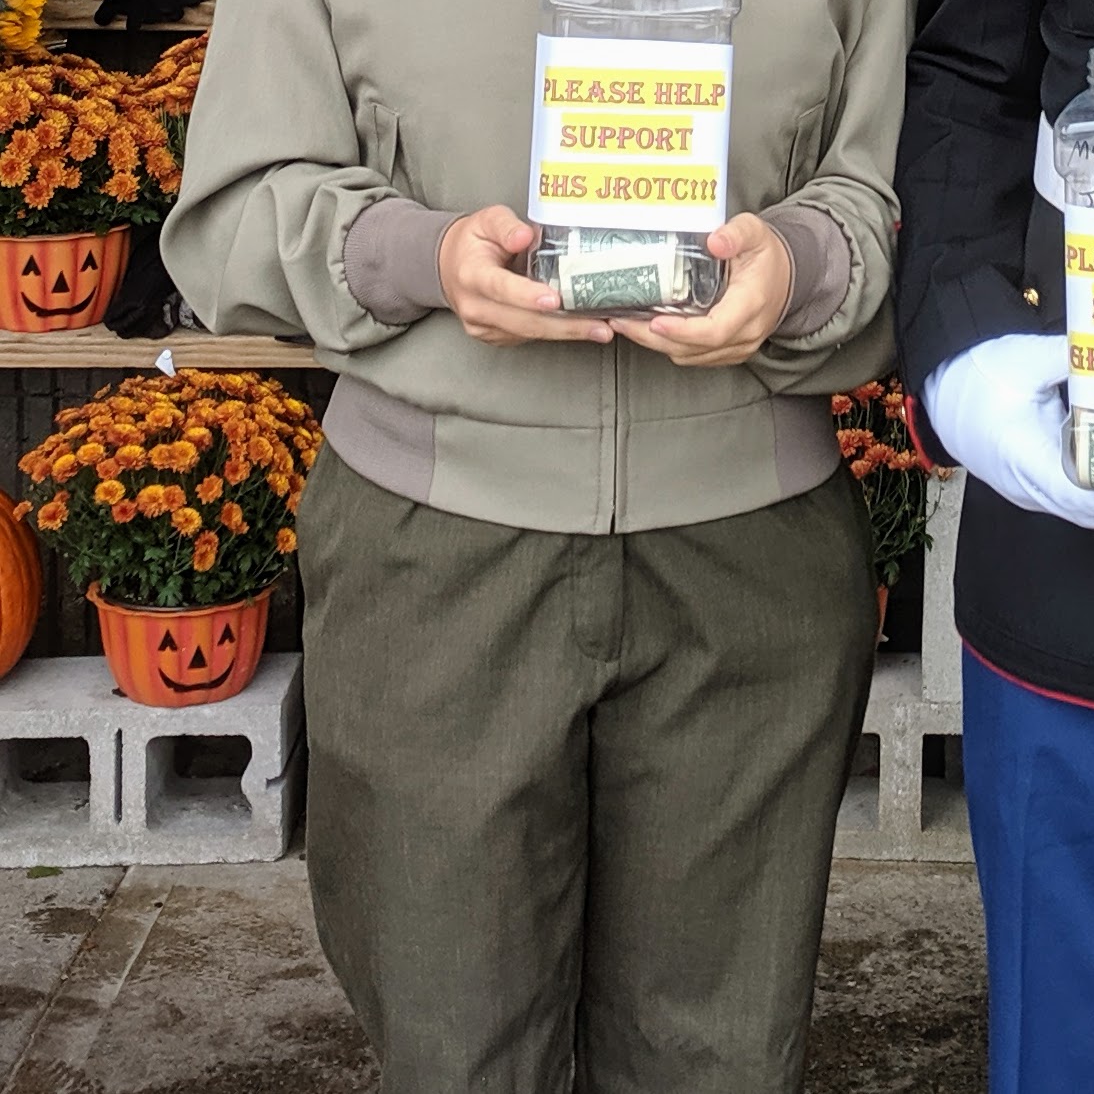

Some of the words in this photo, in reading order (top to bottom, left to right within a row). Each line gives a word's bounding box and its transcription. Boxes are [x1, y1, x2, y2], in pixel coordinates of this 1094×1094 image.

[543, 78, 646, 105] PLEASE
[654, 82, 726, 106] HELP
[559, 125, 694, 152] SUPPORT
[539, 173, 588, 199] GHS
[595, 176, 717, 201] JROTC!!!
